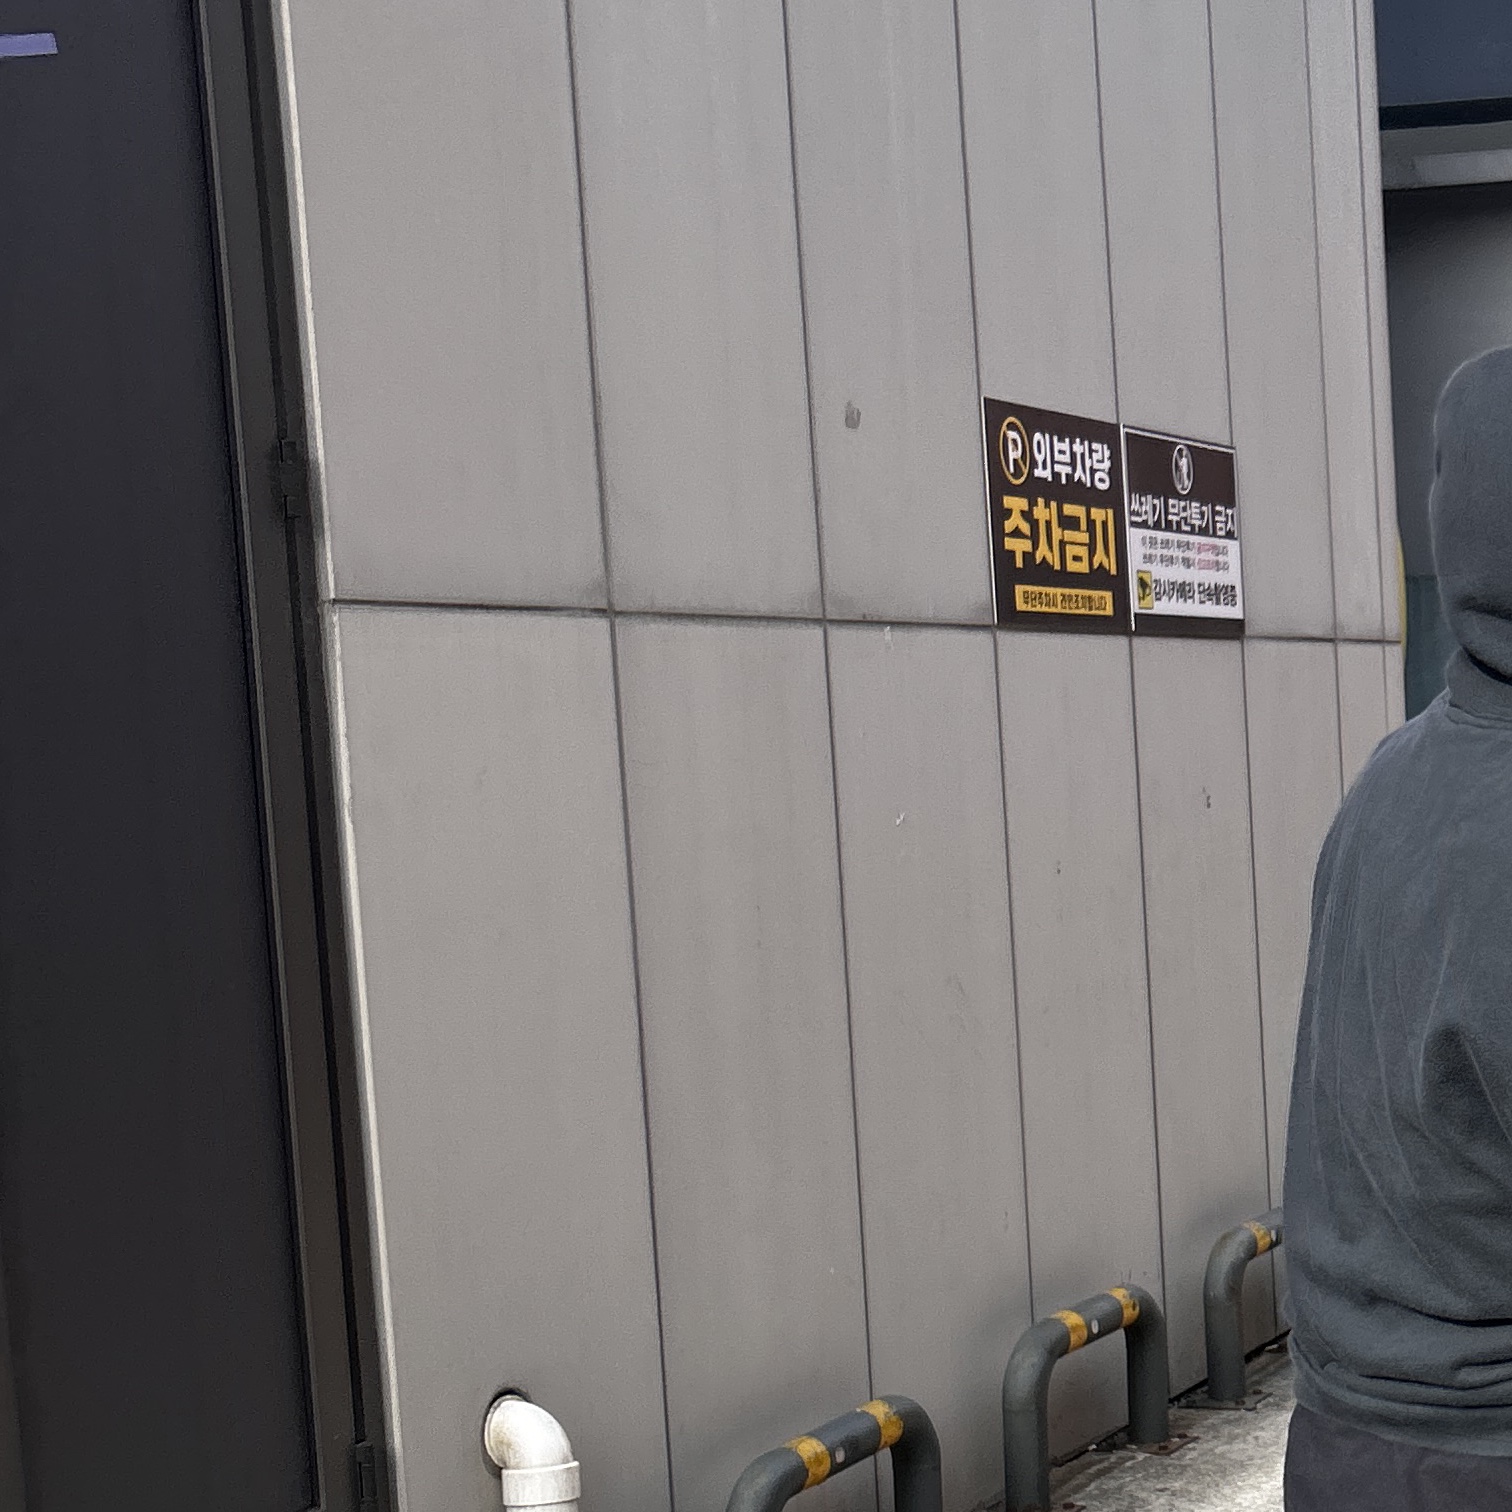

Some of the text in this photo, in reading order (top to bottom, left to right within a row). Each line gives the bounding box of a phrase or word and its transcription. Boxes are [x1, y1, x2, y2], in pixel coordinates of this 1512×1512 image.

[1033, 432, 1112, 491] 외부차량
[1003, 496, 1117, 575] 주차금지
[1131, 493, 1237, 538] 쓰레기 무단투기 금지
